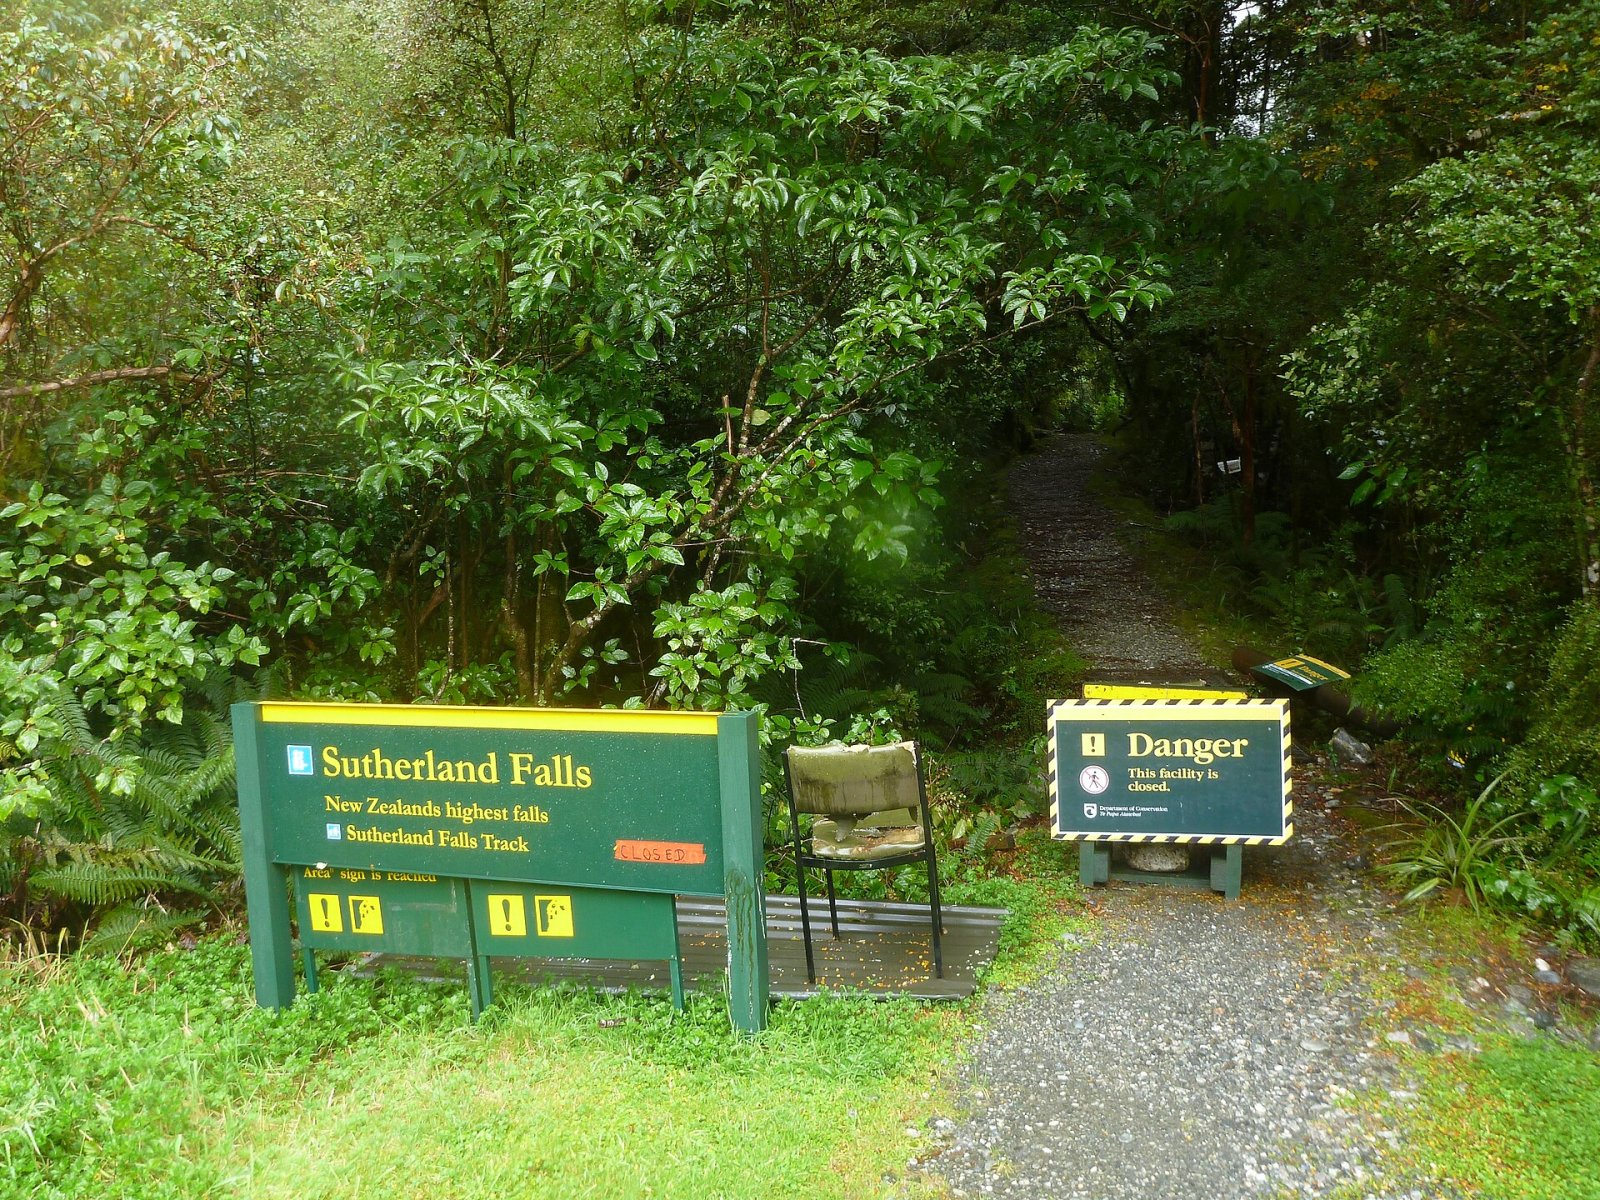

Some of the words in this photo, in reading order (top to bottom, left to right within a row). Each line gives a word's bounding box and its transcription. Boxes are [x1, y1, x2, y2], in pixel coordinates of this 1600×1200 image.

[1127, 733, 1248, 765] Danger
[322, 746, 500, 784] Sutherland
[509, 752, 593, 788] Falls
[1128, 768, 1156, 779] This
[1159, 768, 1204, 781] facility
[1208, 768, 1218, 779] is
[1128, 781, 1171, 792] closed.
[324, 795, 363, 813] New
[367, 797, 441, 817] Zealands
[445, 801, 509, 824] highest
[513, 804, 549, 824] falls
[346, 824, 434, 846] Sutherland
[438, 830, 478, 849] Falls
[480, 834, 530, 852] Track
[620, 845, 686, 861] CLOSED
[340, 869, 366, 882] sign
[371, 870, 381, 880] is
[387, 871, 437, 882] reached
